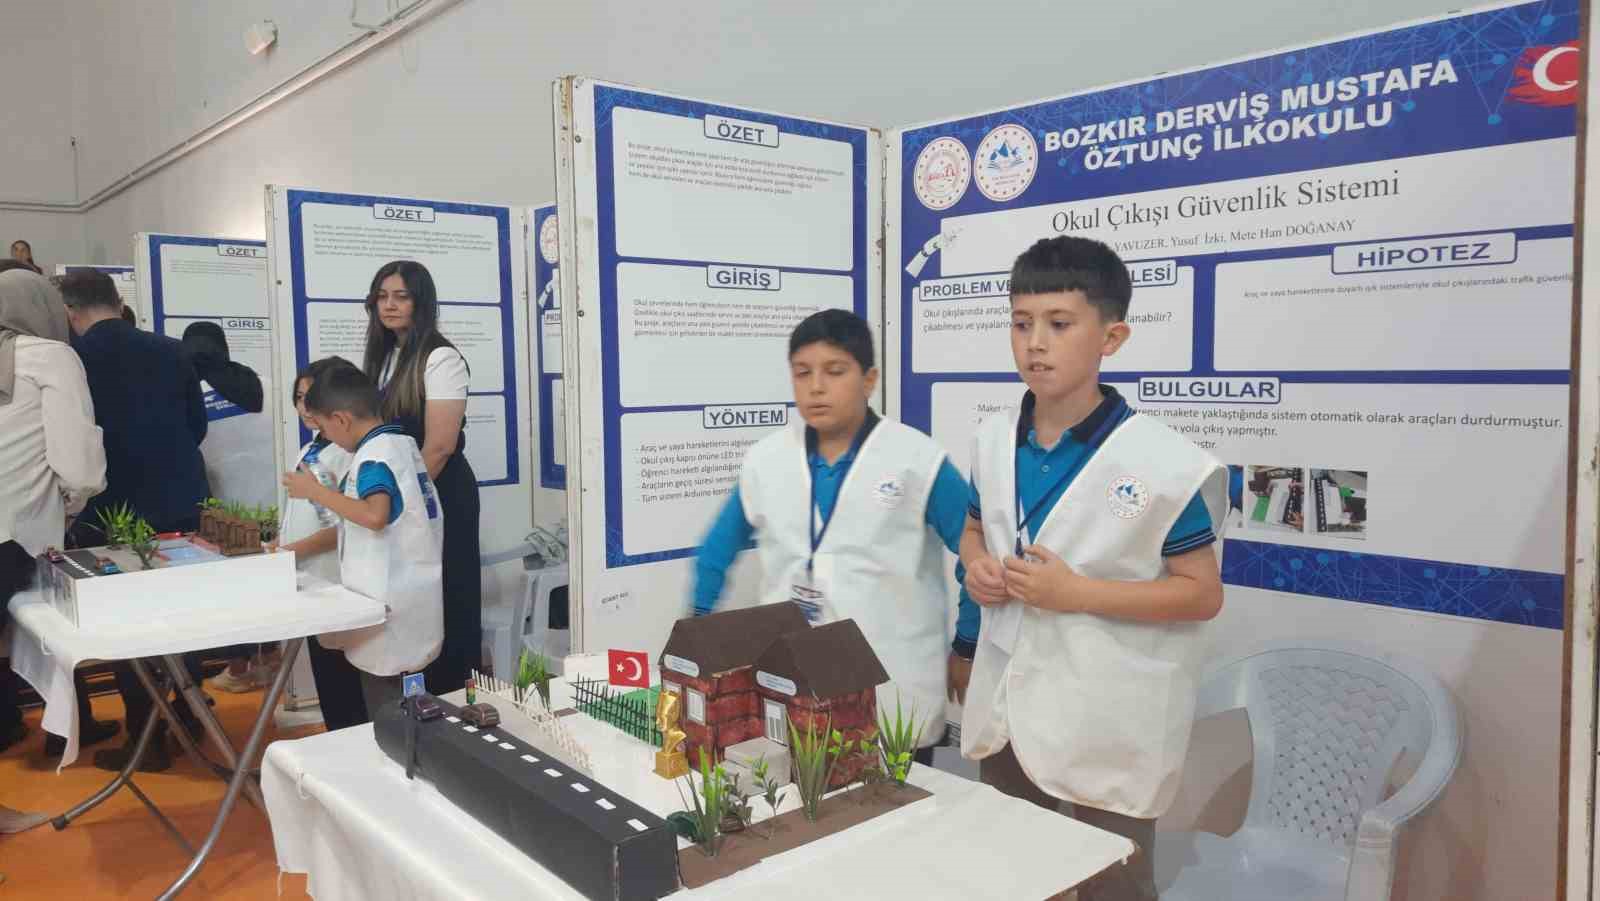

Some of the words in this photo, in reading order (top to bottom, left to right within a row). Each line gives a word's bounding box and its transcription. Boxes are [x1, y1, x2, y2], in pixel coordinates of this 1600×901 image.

[1043, 115, 1146, 153] BOZKIR
[1156, 90, 1270, 133] DERVİŞ
[1281, 59, 1458, 112] MUSTAFA
[717, 119, 765, 143] ÖZET
[1084, 133, 1202, 171] ÖZTUNÇ
[1213, 101, 1392, 152] İLKOKULU
[1052, 208, 1100, 233] Okul
[1107, 203, 1169, 228] Çıkışı
[1177, 185, 1287, 220] Güvenlik
[1297, 169, 1400, 206] Sistemi
[384, 207, 423, 221] ÖZET
[1170, 234, 1199, 247] Yusuf
[1230, 230, 1256, 242] Mete
[1260, 228, 1282, 239] Han
[1286, 219, 1356, 237] DOĞANAY
[1357, 242, 1491, 268] HİPOTEZ
[716, 267, 771, 290] GİRİŞ
[923, 280, 992, 297] PROBLEM
[1132, 265, 1172, 283] LESİ
[1142, 381, 1276, 398] BULGULAR
[709, 408, 783, 426] YÖNTEM
[1164, 409, 1200, 418] makete
[1202, 409, 1268, 422] yaklaştığında
[1272, 411, 1307, 421] sistem
[1310, 411, 1363, 423] otomatik
[1366, 411, 1404, 424] olarak
[1408, 412, 1456, 427] araçları
[1460, 413, 1563, 430] durdurmuştur.
[1180, 424, 1199, 435] yola
[1202, 424, 1224, 436] çıkış
[1226, 425, 1278, 437] yapmıştır.
